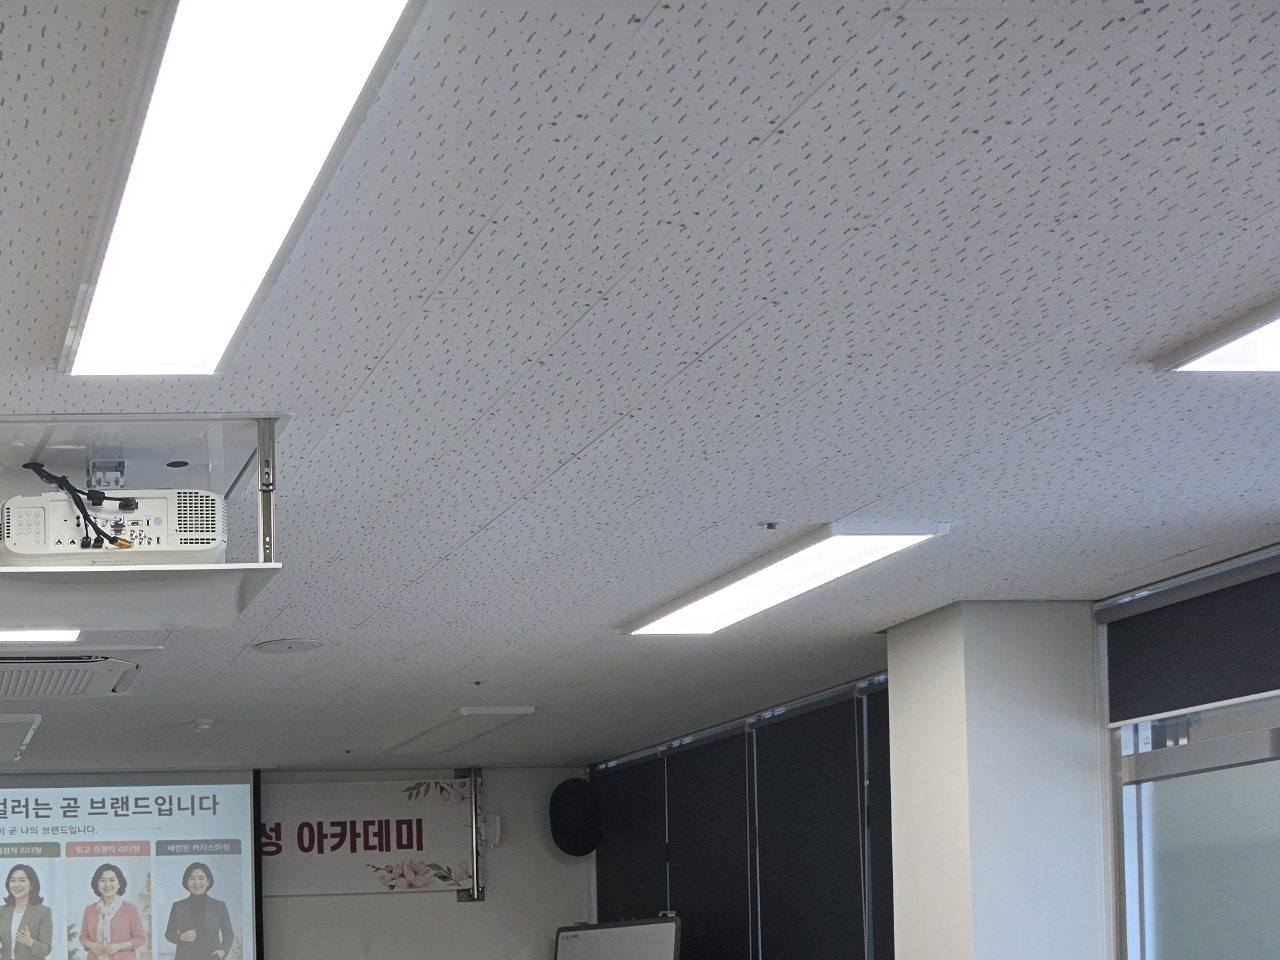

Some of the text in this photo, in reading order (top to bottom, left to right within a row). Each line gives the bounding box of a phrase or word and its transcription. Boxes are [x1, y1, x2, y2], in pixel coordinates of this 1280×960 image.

[60, 797, 81, 819] 곧
[87, 794, 220, 818] 브랜드입니다
[8, 826, 18, 836] 곧
[20, 825, 39, 836] 나의
[41, 824, 98, 835] 브랜드입니다.
[296, 818, 424, 855] 아카데미
[20, 846, 43, 855] 리더형
[75, 845, 141, 854] 밝고 긍정적 리더형
[166, 843, 231, 853] 세련된 카리스마형
